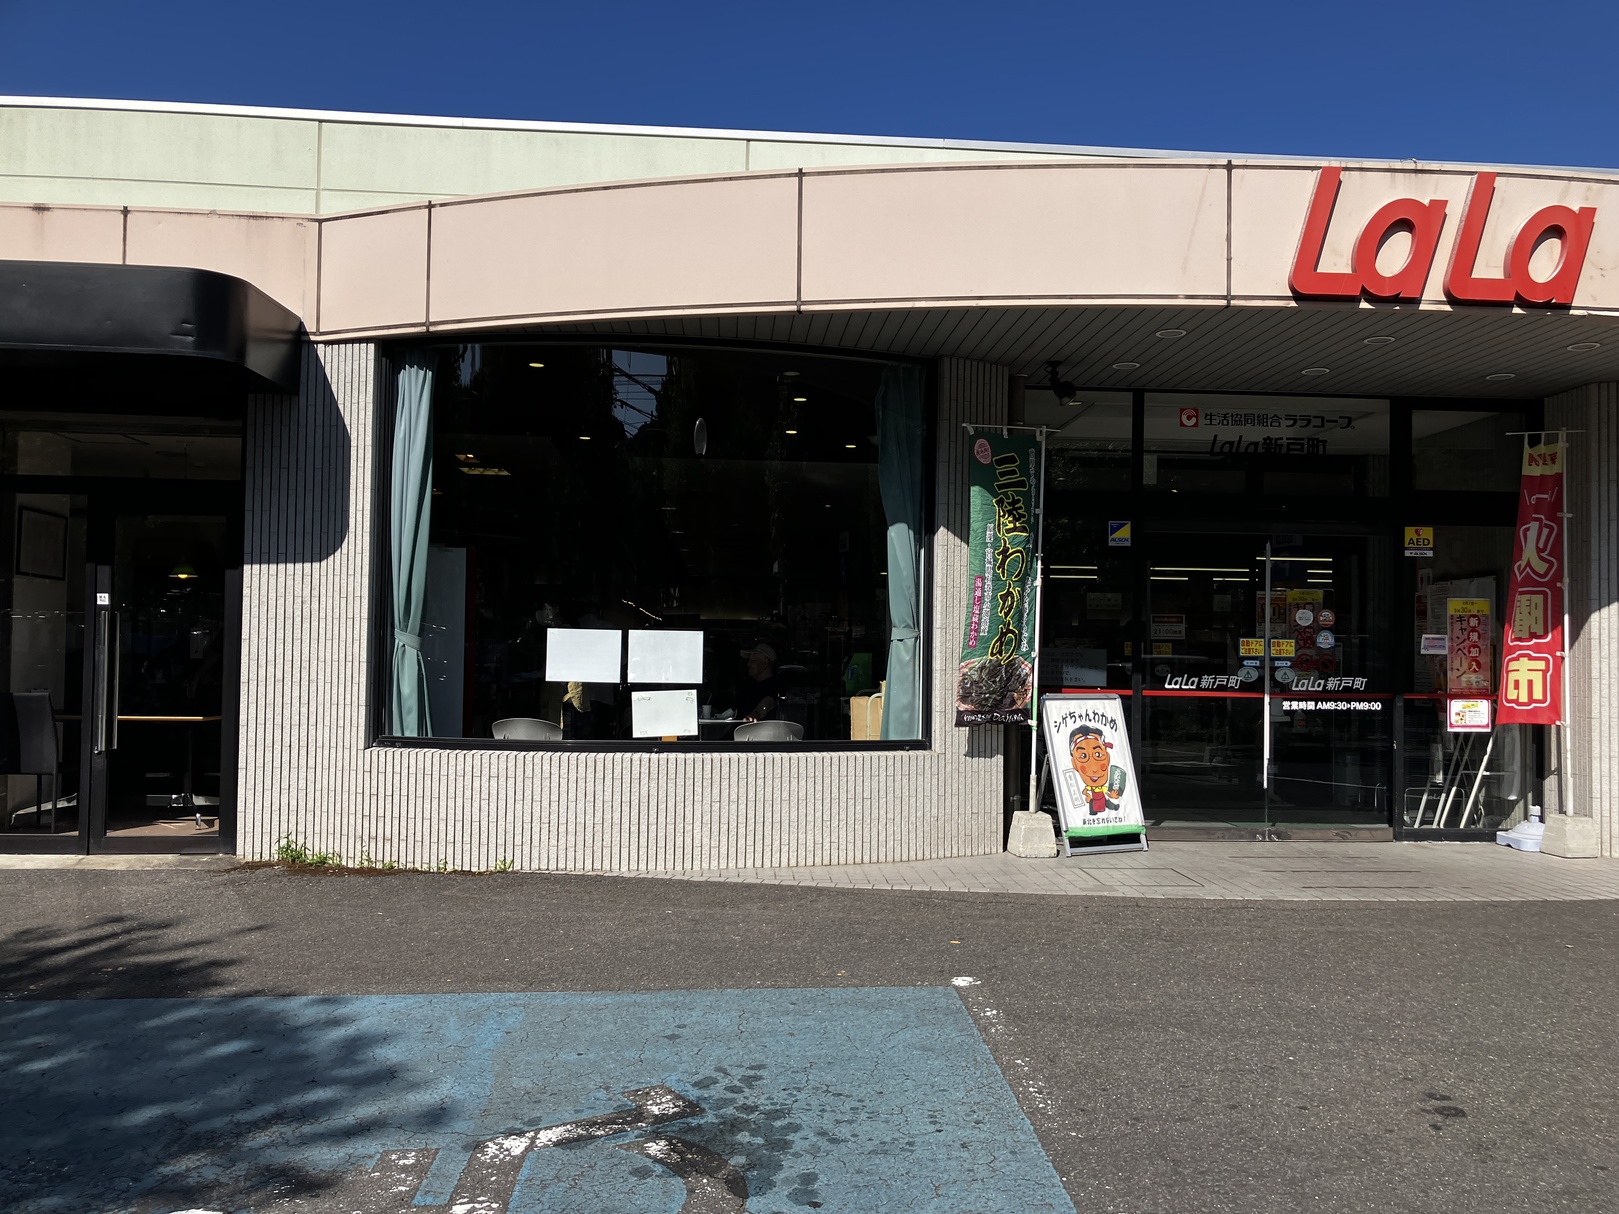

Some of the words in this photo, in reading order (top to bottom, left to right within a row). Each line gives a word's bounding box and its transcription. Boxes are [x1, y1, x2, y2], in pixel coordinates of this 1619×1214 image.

[1287, 166, 1597, 304] LaLa
[1407, 537, 1430, 546] AED
[987, 452, 1029, 666] 三陸わかめ
[1455, 614, 1467, 679] キャンペーン
[1468, 616, 1480, 673] 新規加入
[1164, 674, 1198, 689] LaLa
[1199, 674, 1242, 689] 新戸町
[1291, 676, 1323, 691] LaLa
[1325, 676, 1367, 691] 新戸町
[1282, 701, 1315, 711] 営業時間
[1053, 708, 1118, 734] シゲちゃんわかめ
